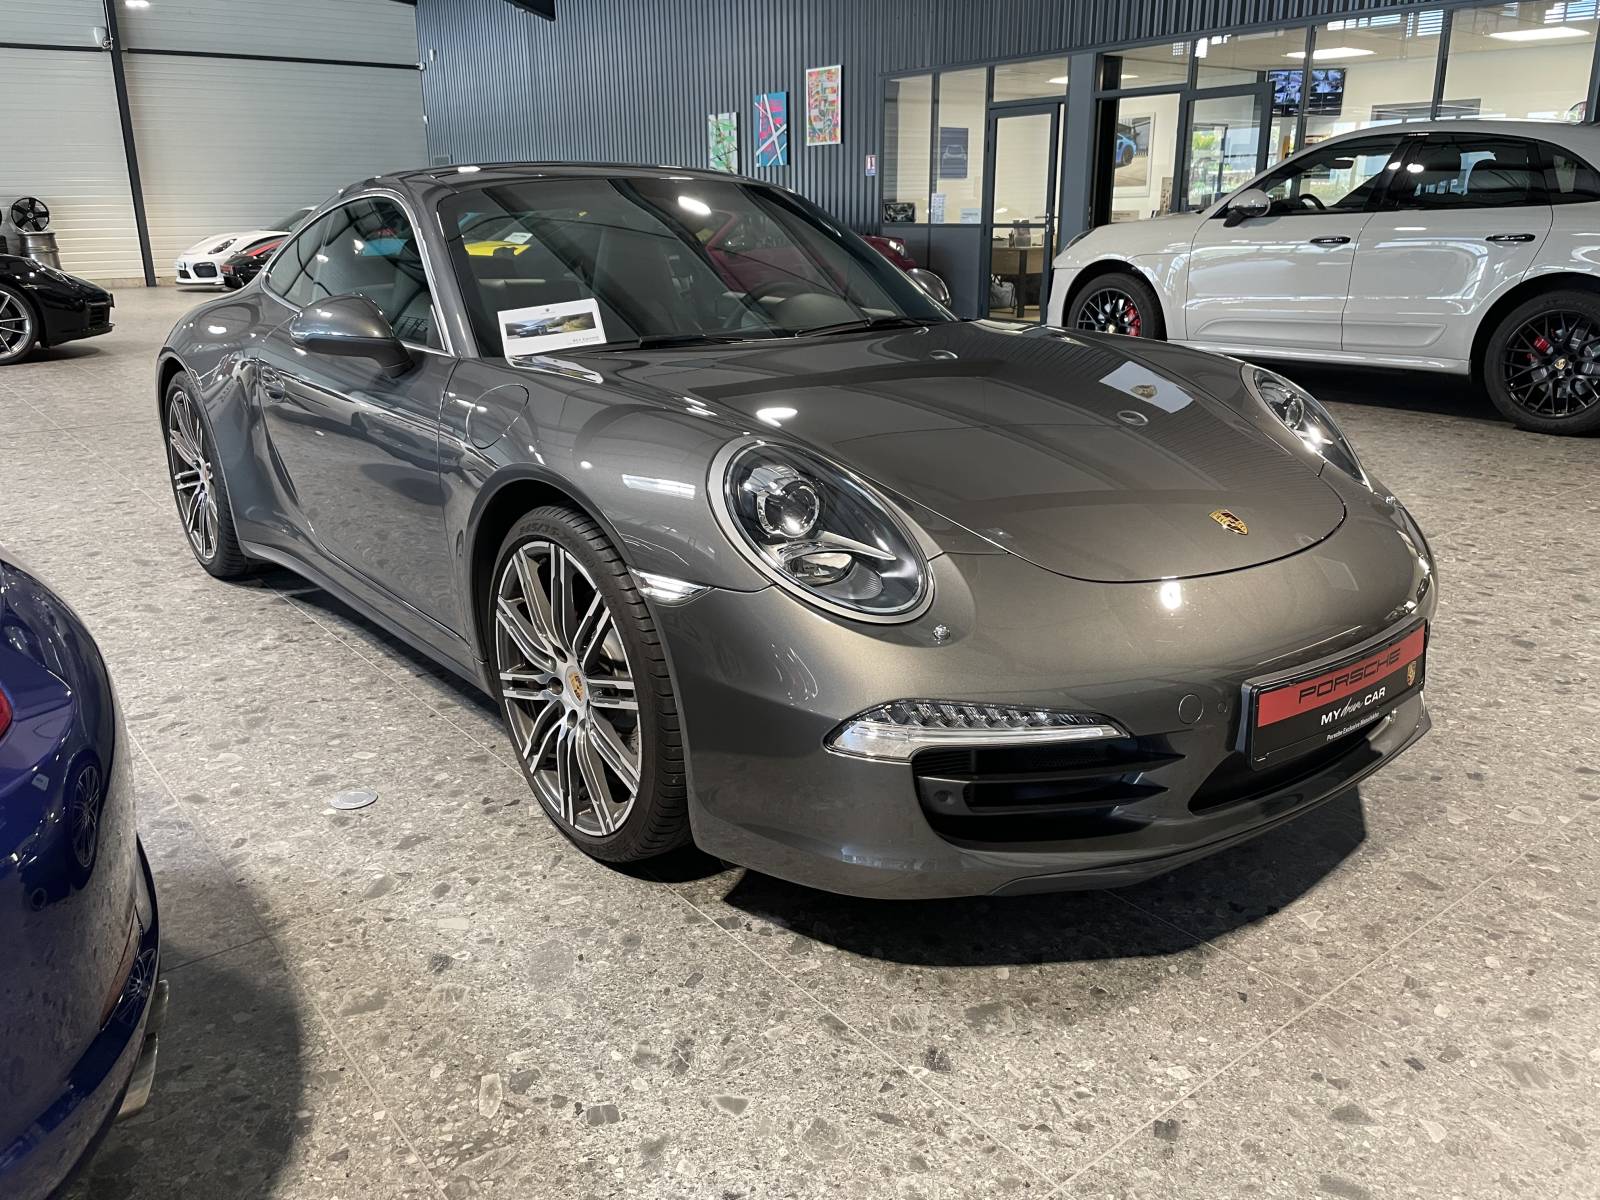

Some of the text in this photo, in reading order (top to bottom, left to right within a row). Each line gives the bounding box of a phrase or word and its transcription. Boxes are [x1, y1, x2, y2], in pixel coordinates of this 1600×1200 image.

[1298, 648, 1401, 704] PORSCHE
[1320, 708, 1342, 726] MY
[1364, 686, 1386, 706] CAR
